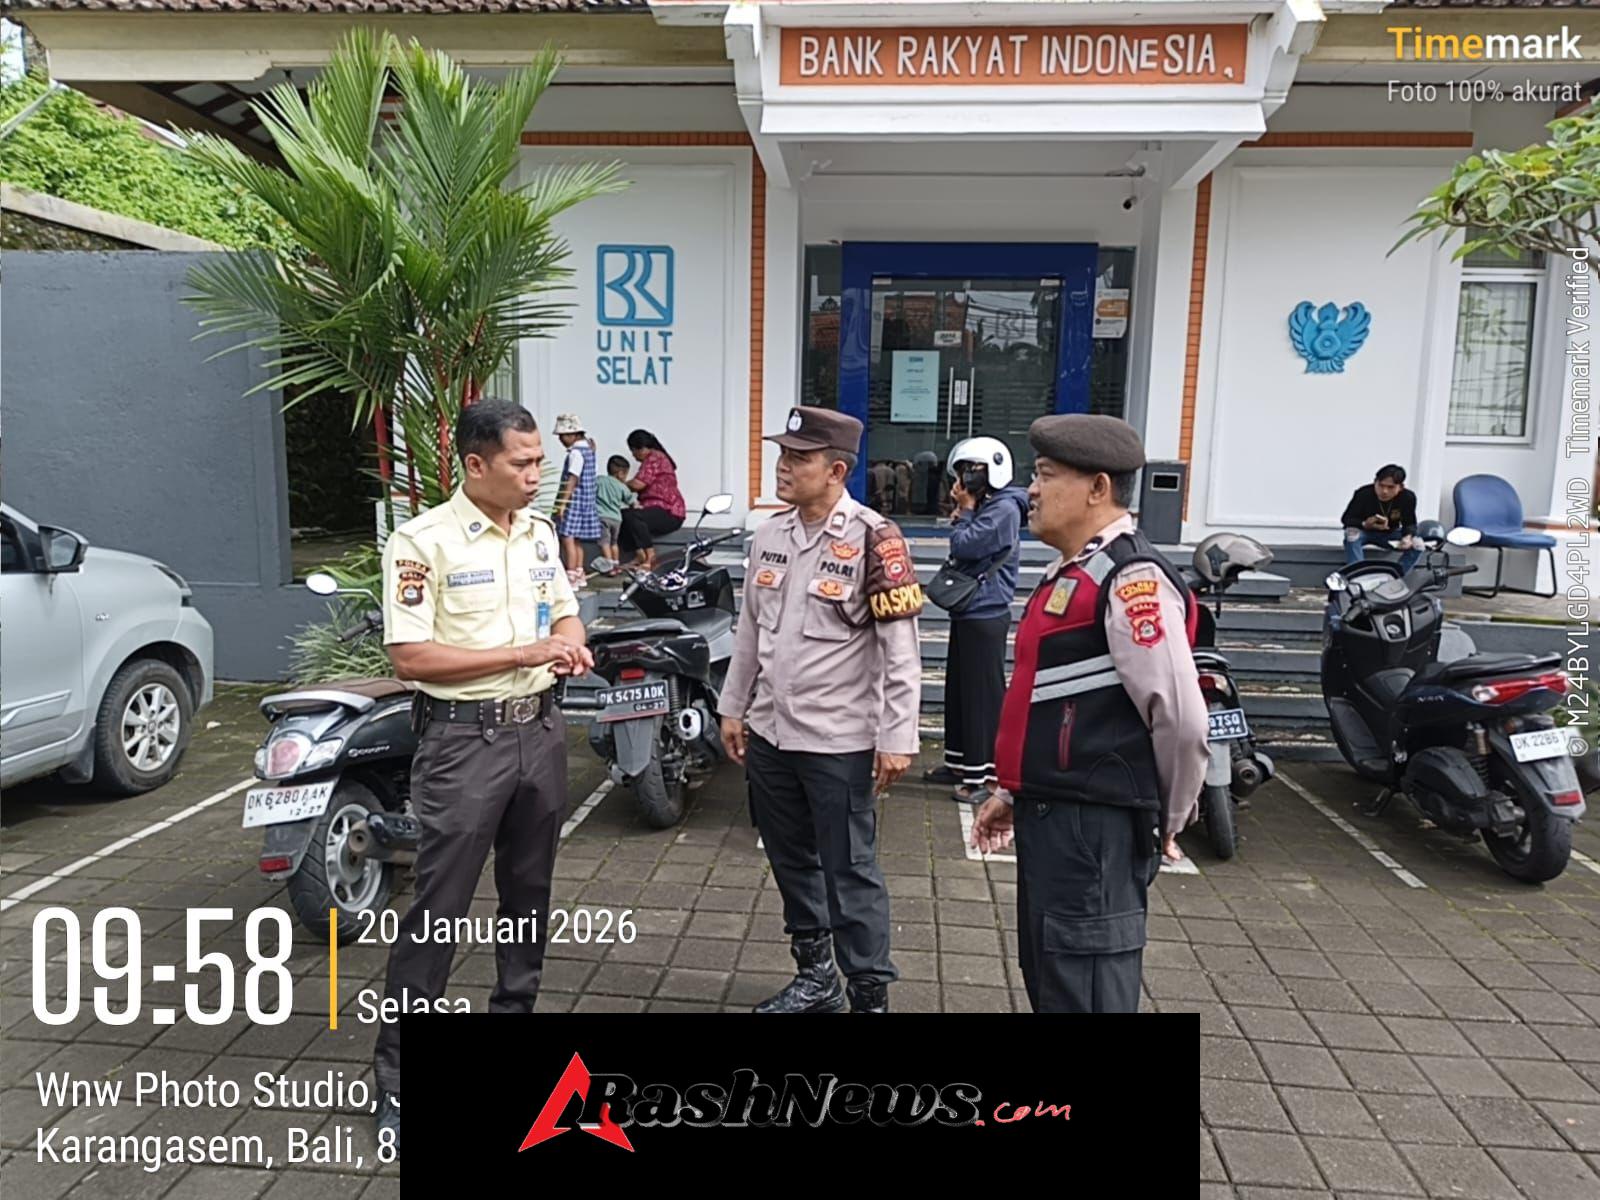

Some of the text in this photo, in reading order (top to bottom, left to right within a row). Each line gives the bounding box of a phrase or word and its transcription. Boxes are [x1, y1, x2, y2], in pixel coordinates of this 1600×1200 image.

[799, 33, 1217, 76] BANK RAKYAT INDONESIA
[597, 329, 673, 352] UNIT
[596, 356, 673, 385] SELAT
[820, 560, 854, 578] POLRI
[615, 688, 642, 703] 5475
[247, 793, 264, 810] DK
[265, 789, 300, 806] 6280
